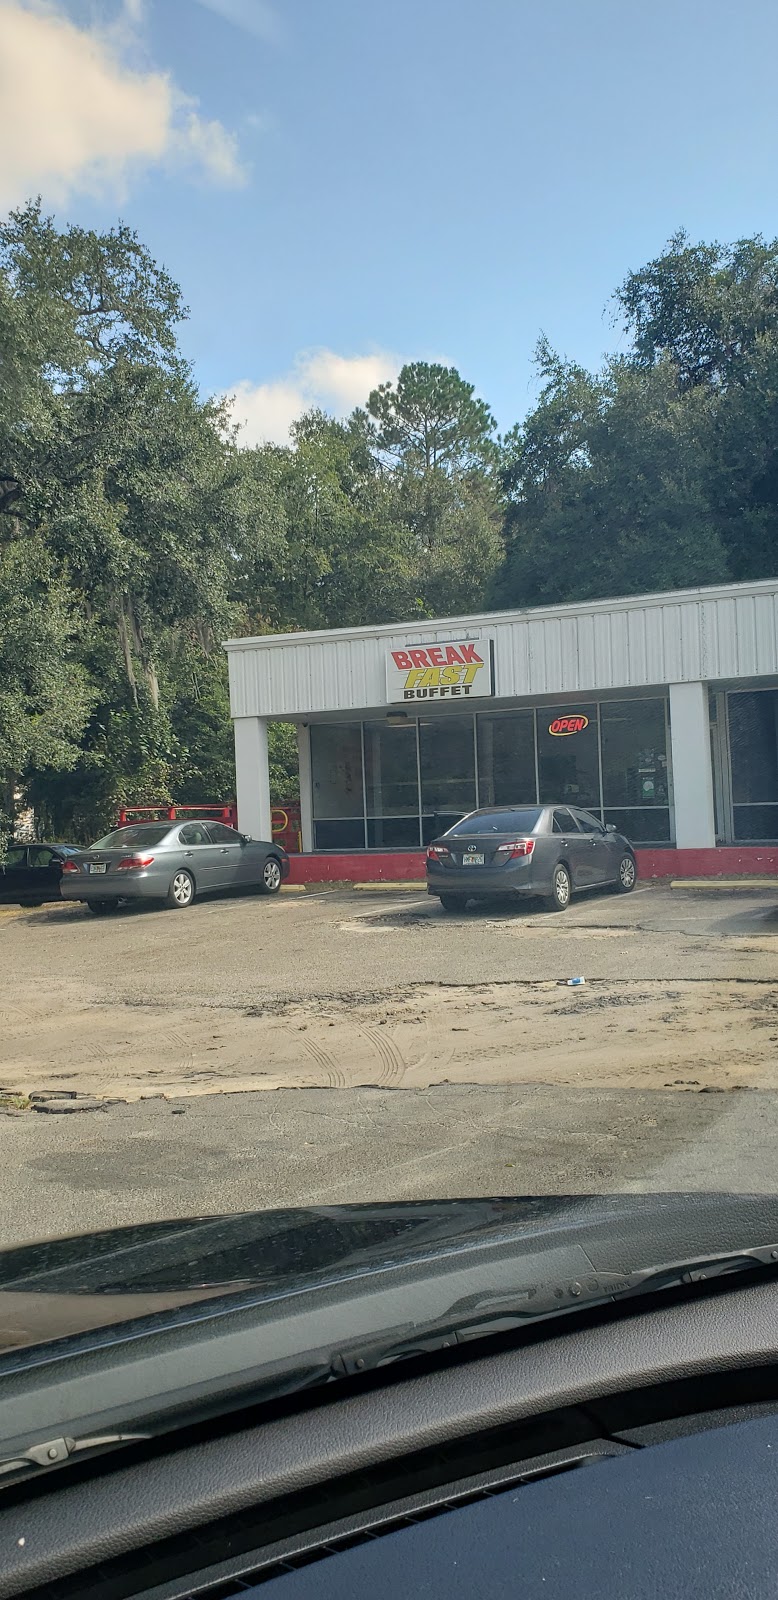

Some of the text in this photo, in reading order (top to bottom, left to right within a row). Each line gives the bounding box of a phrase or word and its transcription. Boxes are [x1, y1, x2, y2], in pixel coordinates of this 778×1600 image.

[391, 644, 484, 670] BREAK
[404, 663, 484, 689] FAST
[403, 685, 472, 699] BUFFET
[551, 719, 584, 732] OPEN
